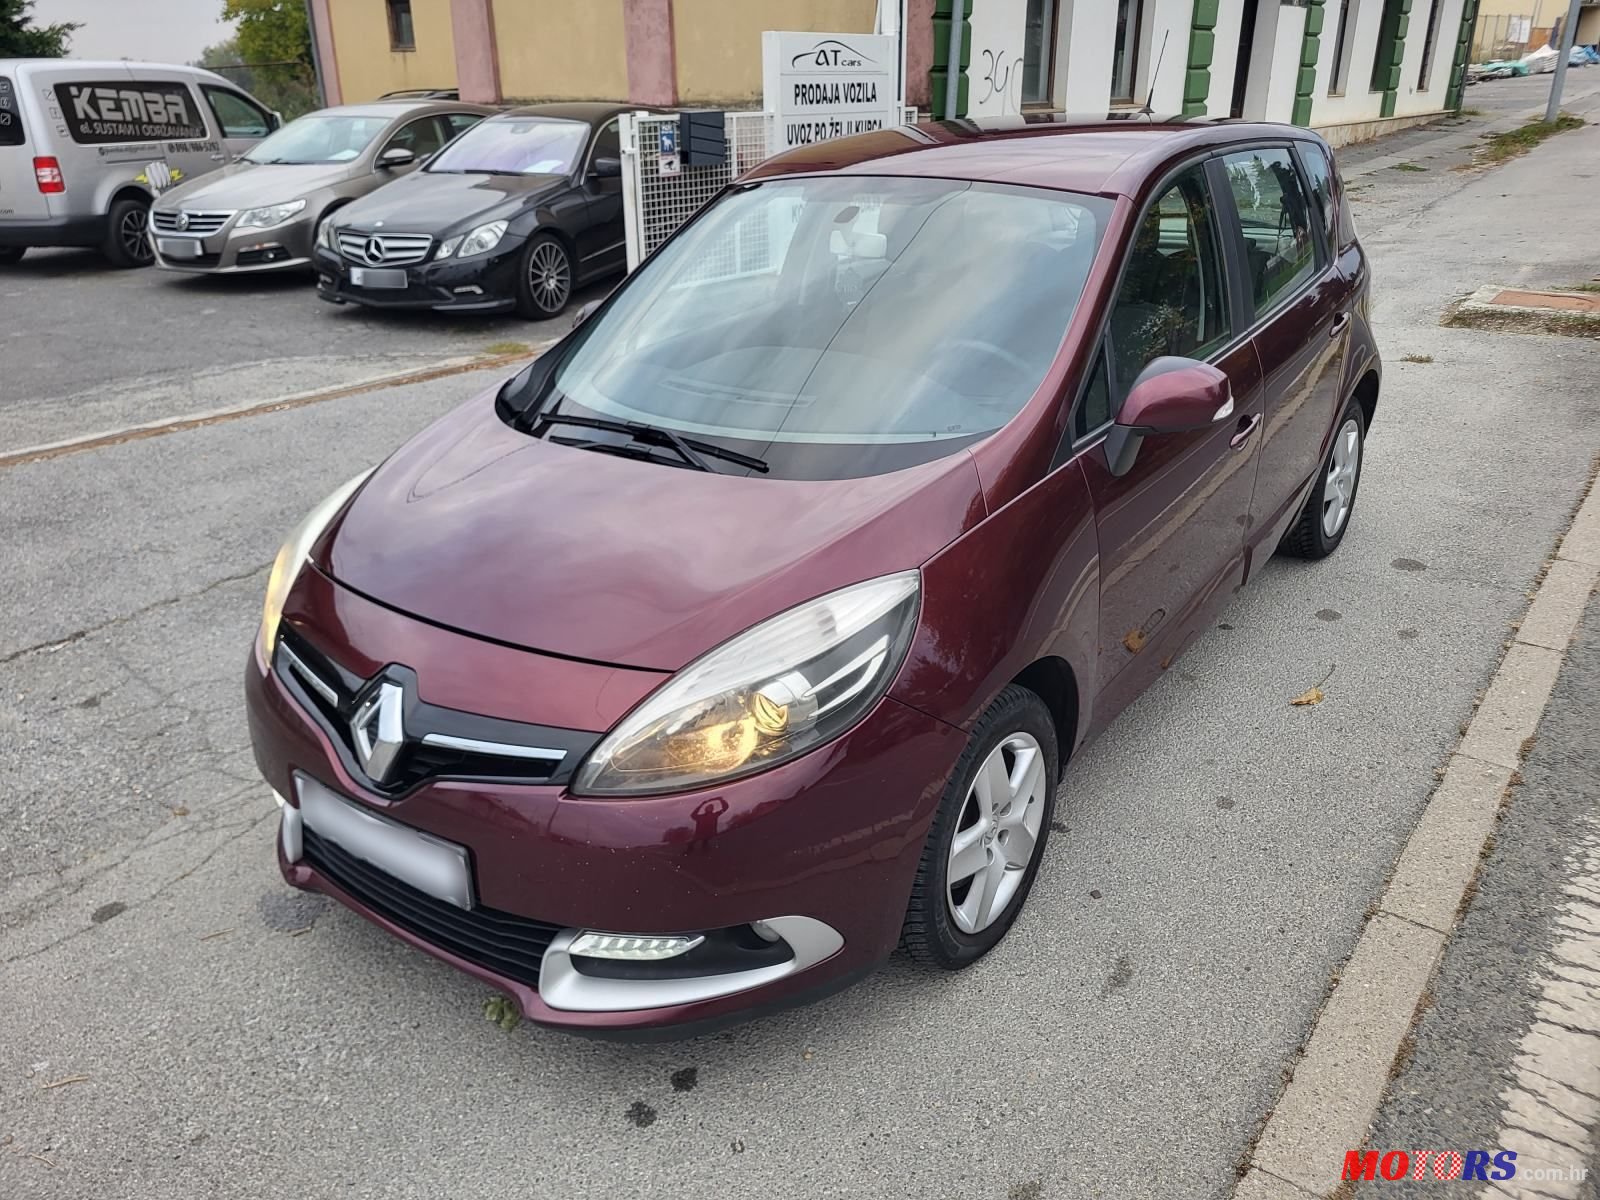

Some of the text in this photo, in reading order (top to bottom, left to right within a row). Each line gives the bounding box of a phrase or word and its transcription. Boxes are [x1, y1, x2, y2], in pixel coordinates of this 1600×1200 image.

[815, 49, 862, 67] AT cars
[69, 86, 189, 124] KEMBA
[794, 82, 877, 106] PRODAJA VOZILA
[787, 123, 812, 145] UVOZ
[815, 121, 827, 142] PO
